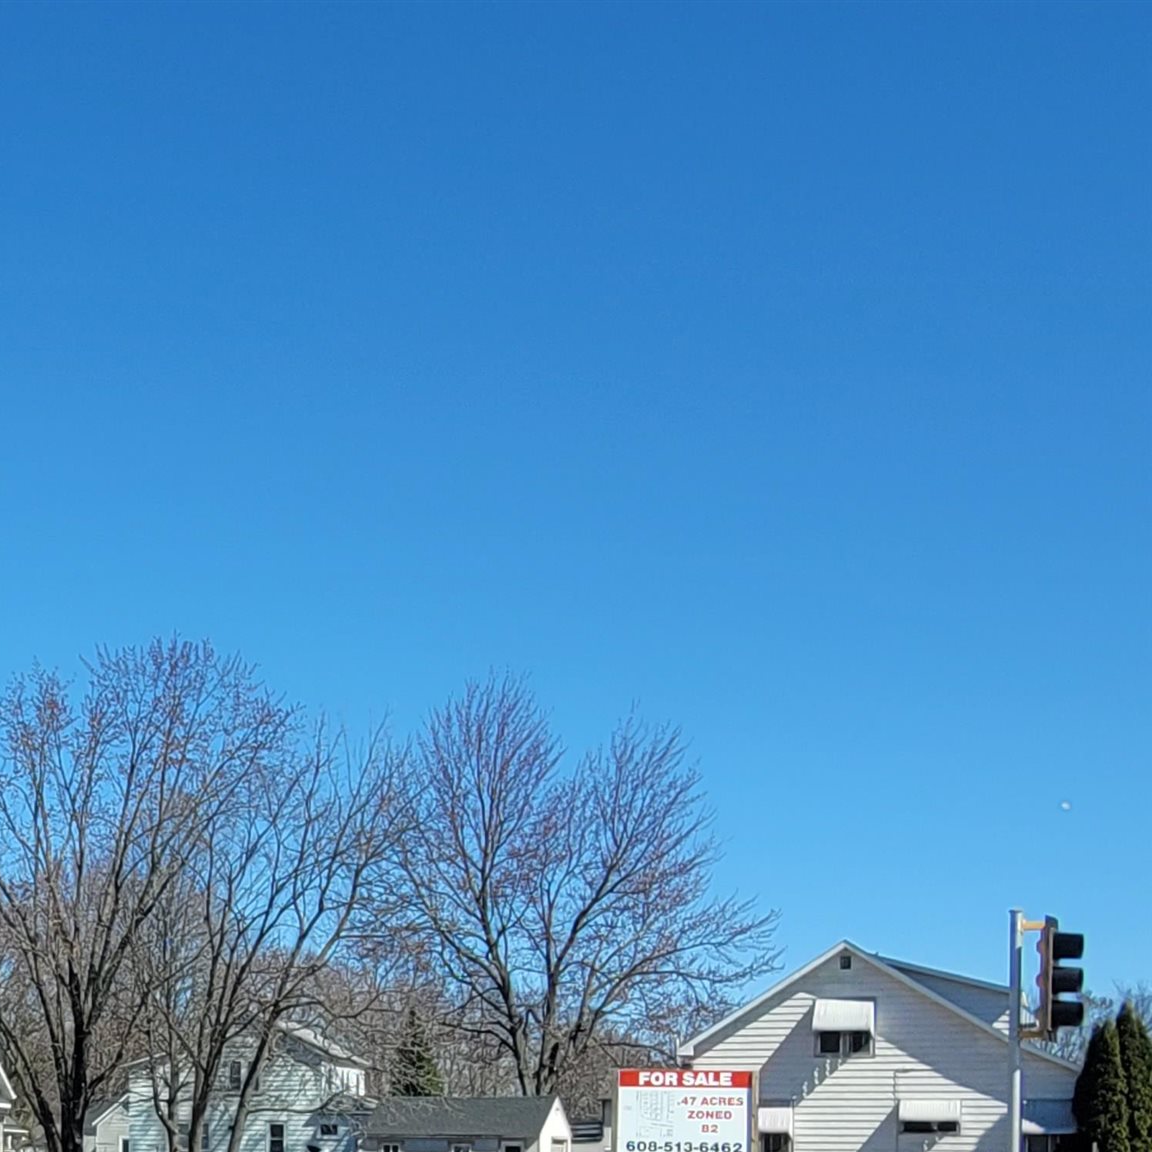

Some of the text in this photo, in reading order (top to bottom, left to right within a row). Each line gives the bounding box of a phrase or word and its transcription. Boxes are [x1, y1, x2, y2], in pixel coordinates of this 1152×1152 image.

[638, 1072, 733, 1086] FOR SALE
[677, 1097, 744, 1106] .47 ACRES
[687, 1110, 732, 1120] ZONED
[701, 1124, 719, 1133] B2
